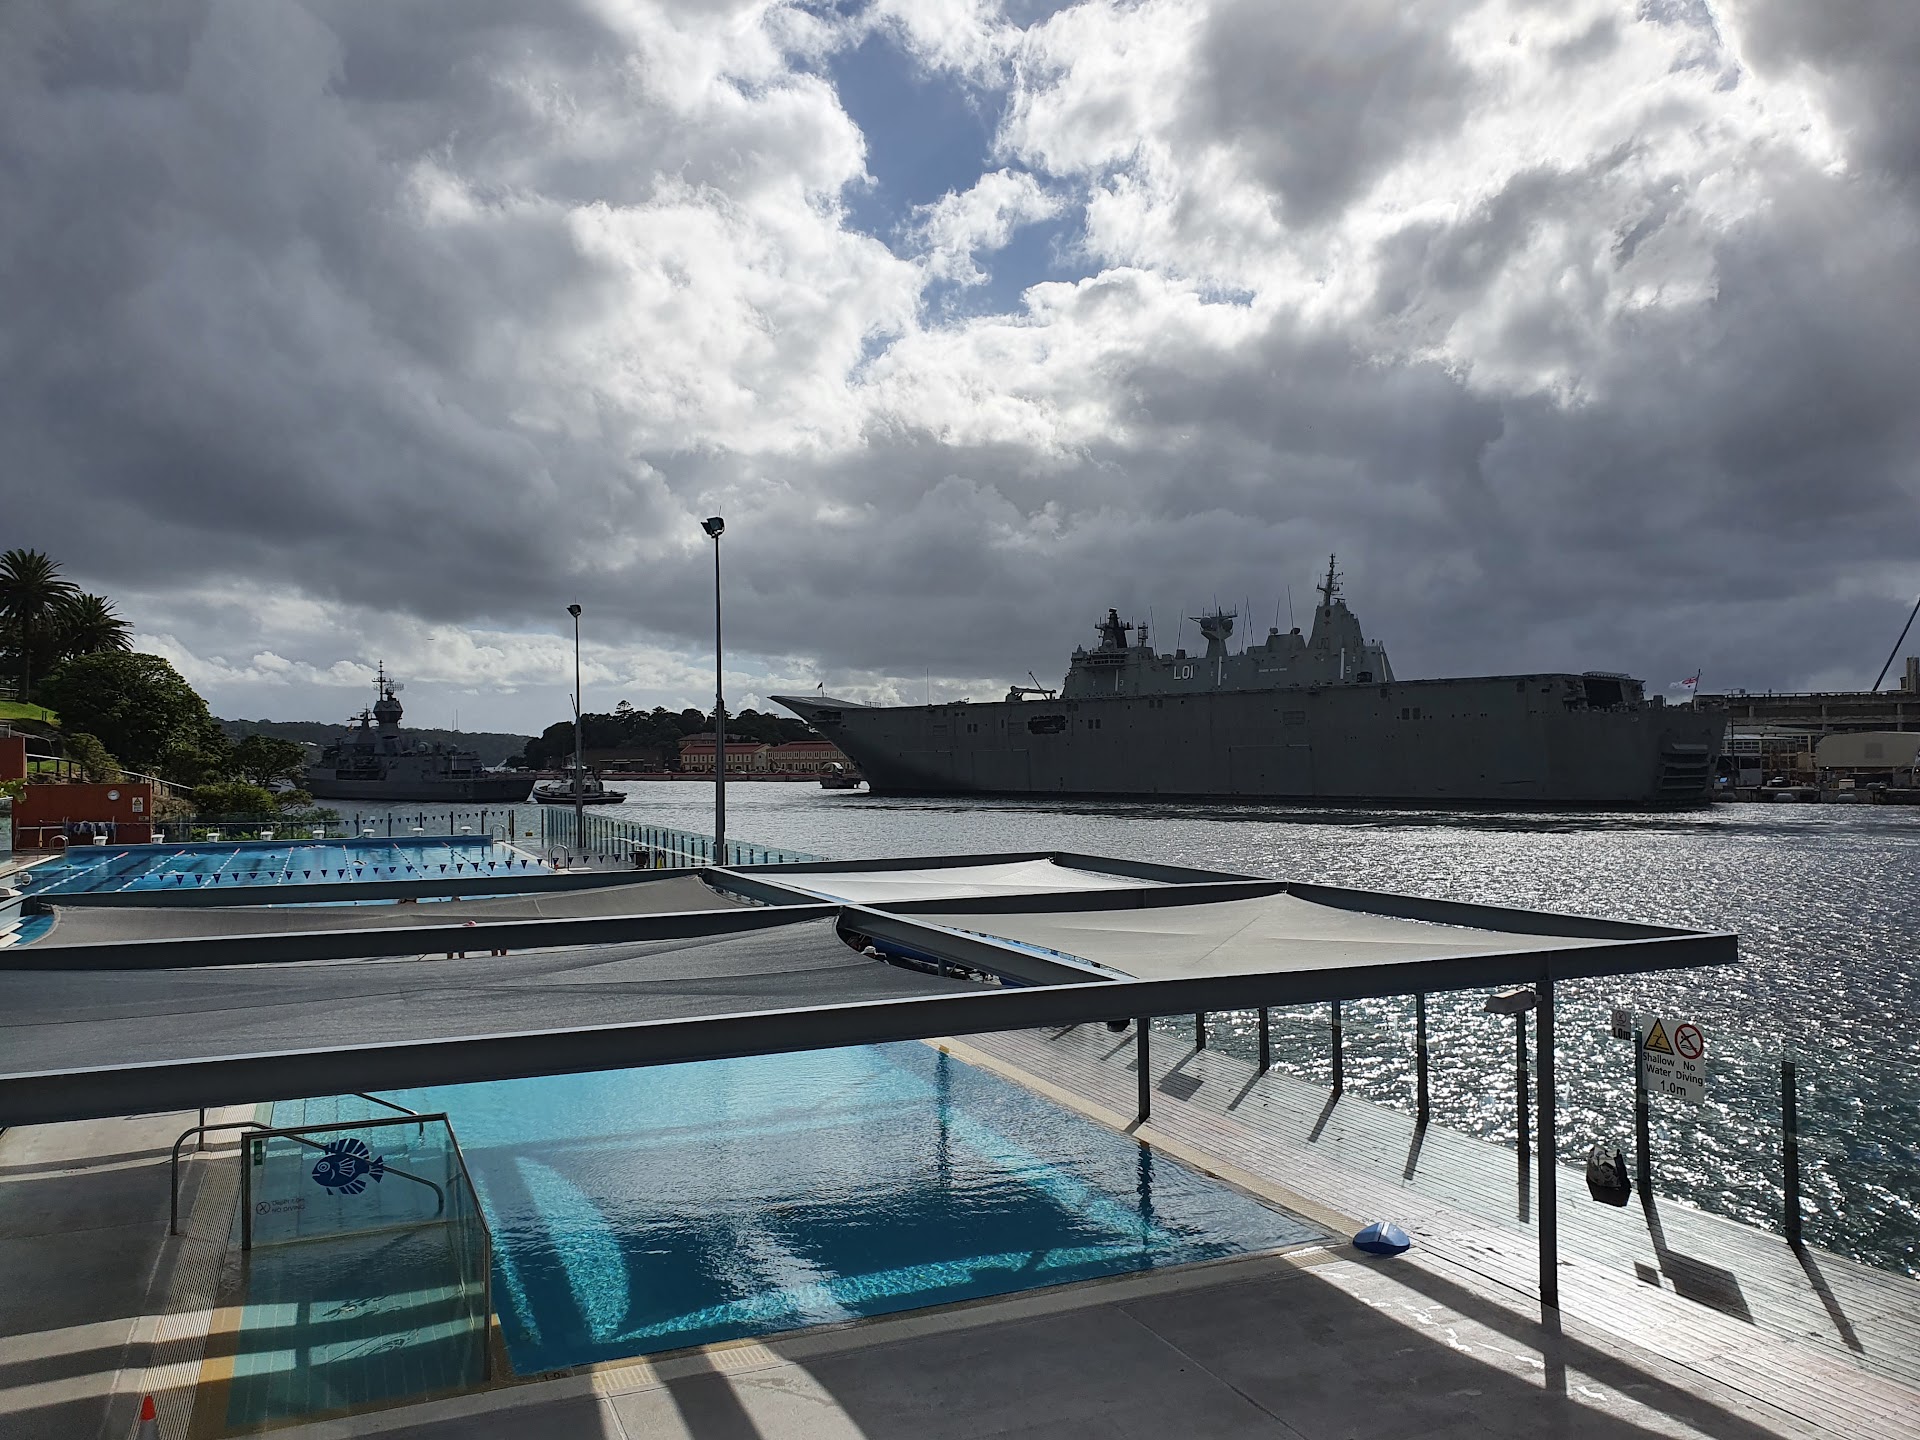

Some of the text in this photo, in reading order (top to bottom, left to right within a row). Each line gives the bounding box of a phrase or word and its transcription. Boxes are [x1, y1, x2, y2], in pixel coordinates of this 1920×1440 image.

[1642, 1052, 1675, 1067] Shallow
[1683, 1061, 1696, 1072] No
[1646, 1064, 1671, 1078] Water
[1675, 1071, 1703, 1087] Diving
[1660, 1080, 1686, 1096] 1.0m
